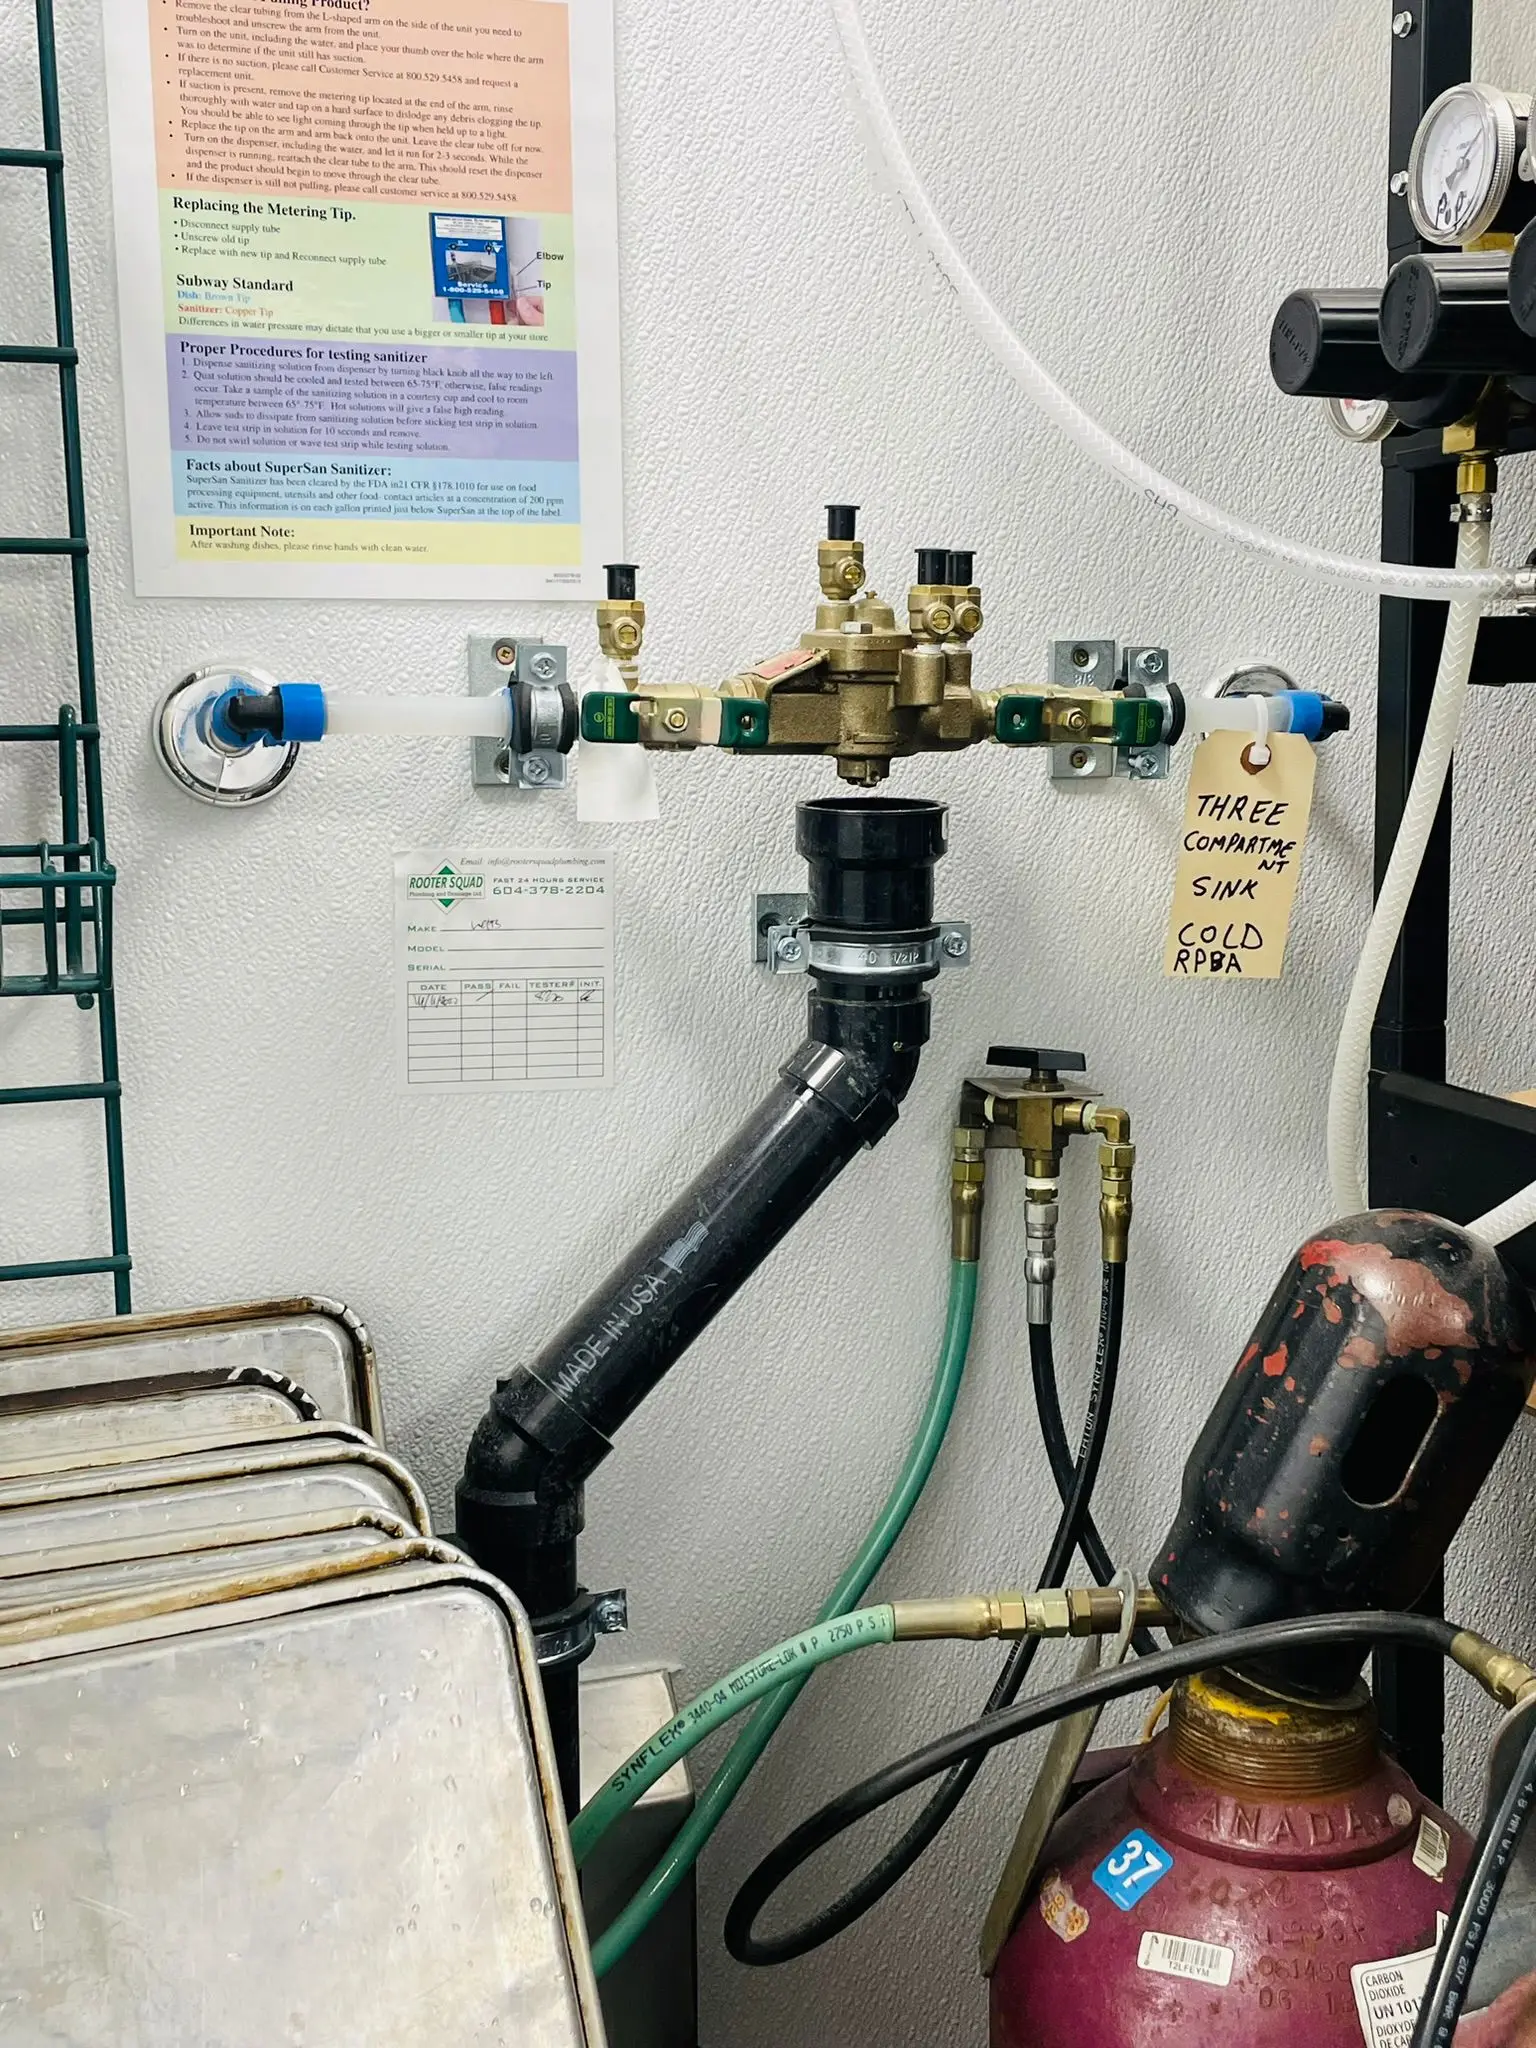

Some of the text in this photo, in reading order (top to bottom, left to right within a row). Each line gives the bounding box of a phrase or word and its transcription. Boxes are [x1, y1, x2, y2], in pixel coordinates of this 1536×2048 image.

[173, 197, 355, 222] Replacing the Metering Tip.
[180, 219, 280, 234] Disconnect supply tube
[180, 232, 251, 246] Unscrew old tip
[182, 245, 216, 257] Replace
[219, 247, 238, 256] with
[260, 250, 272, 260] tip
[274, 251, 289, 259] and
[292, 251, 336, 262] Reconnect
[339, 255, 365, 266] supply
[368, 256, 386, 265] tube
[536, 252, 564, 260] Elbow
[177, 274, 293, 290] Subway Standard
[537, 280, 552, 290] Tip
[180, 341, 427, 362] Proper Procedures for testing sanitizer
[186, 459, 390, 476] Facts about SuperSan Sanitizer:
[190, 524, 294, 538] Important Note:
[190, 539, 212, 548] After
[215, 540, 250, 551] washing
[252, 540, 280, 550] dishes,
[283, 541, 308, 552] please
[333, 542, 358, 551] hands
[381, 543, 402, 551] clean
[1198, 794, 1289, 826] THREE
[1184, 830, 1297, 858] COMPARTME
[1258, 859, 1290, 874] NT
[410, 876, 483, 891] ROOTER SQUAD
[493, 886, 605, 895] 604-378-2204
[1192, 876, 1258, 901] SINK
[1178, 922, 1263, 949] COLD
[1173, 949, 1242, 974] RPBA
[529, 981, 575, 989] TESTER#
[551, 1272, 667, 1399] MADE IN USA
[827, 1623, 854, 1643] 2750
[1107, 1839, 1163, 1889] 37
[1365, 1970, 1404, 1987] CARBON
[1369, 1984, 1406, 2001] DIOXIDE
[1373, 2003, 1395, 2020] UN
[1397, 1996, 1421, 2015] 101
